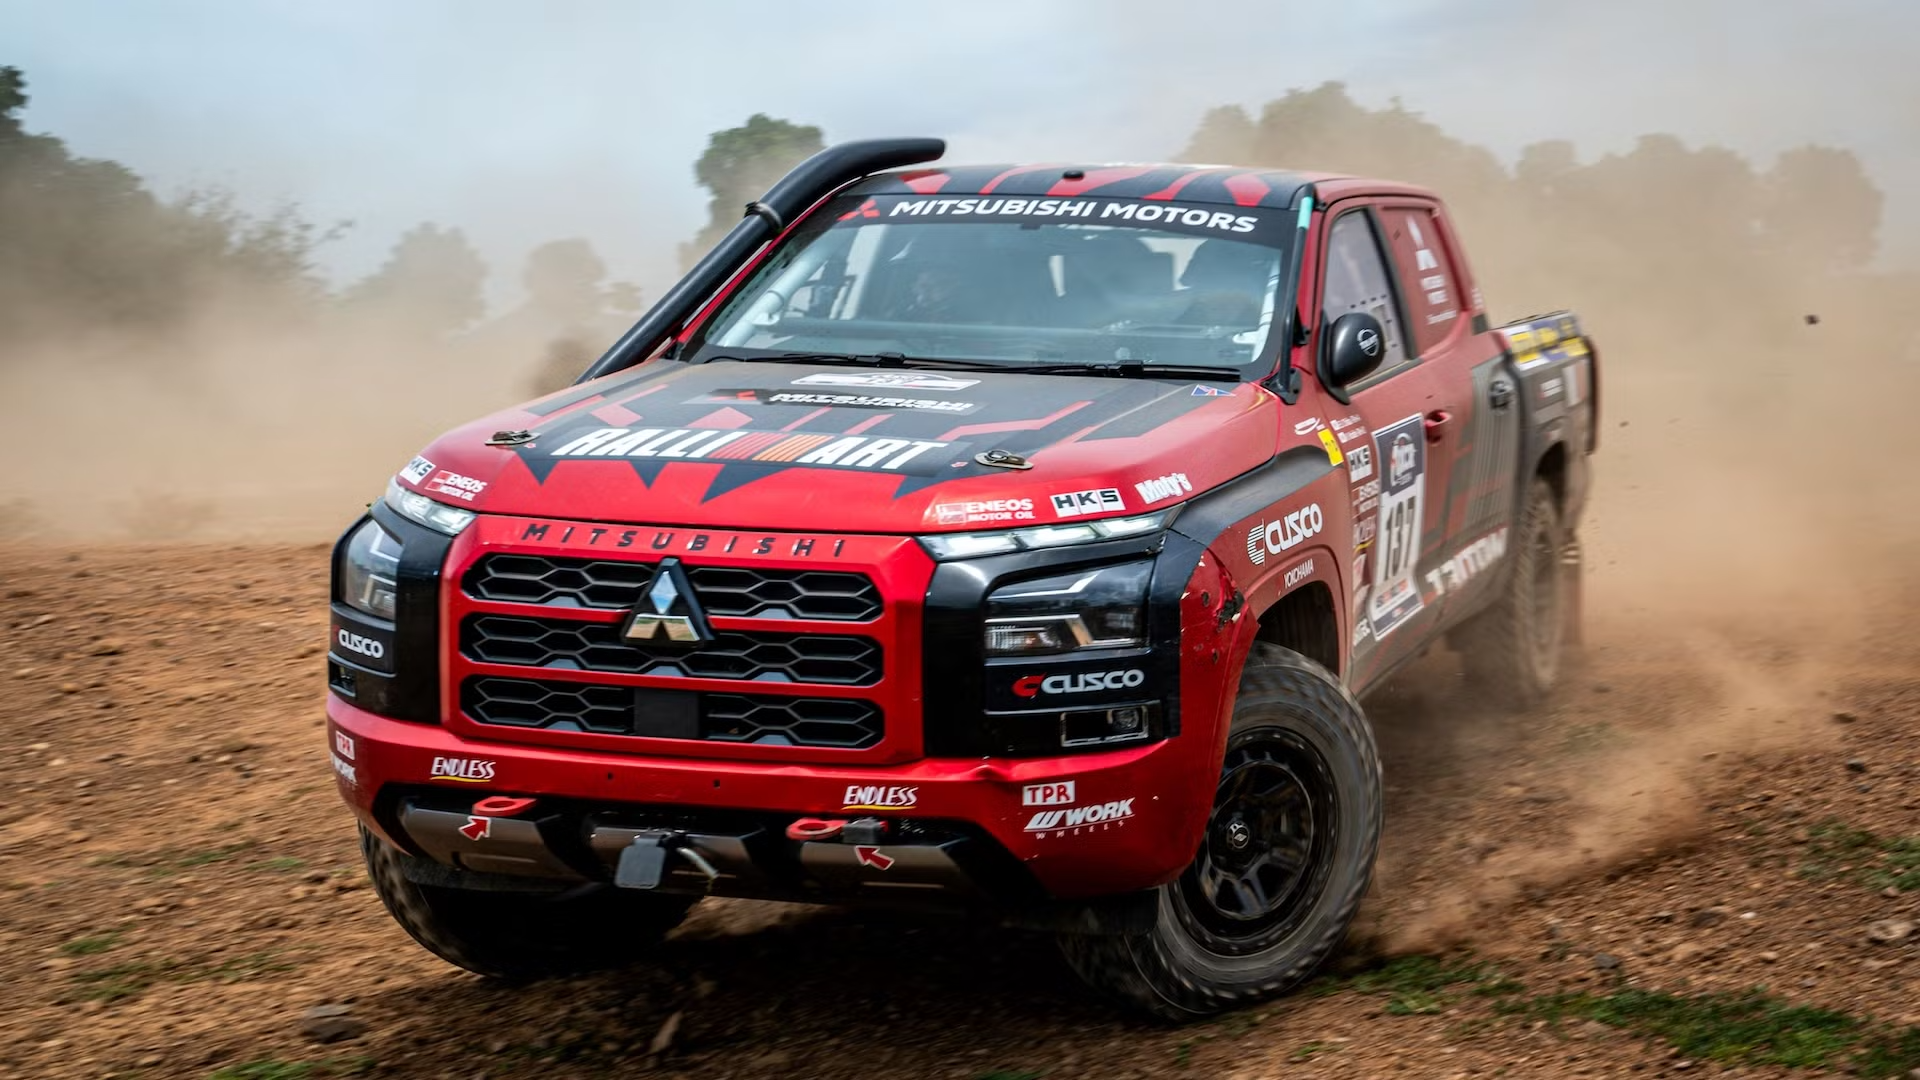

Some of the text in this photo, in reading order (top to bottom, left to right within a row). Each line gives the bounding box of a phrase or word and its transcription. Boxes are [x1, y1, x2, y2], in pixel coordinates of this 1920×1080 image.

[889, 199, 1258, 233] MITSUBISHI MOTORS
[408, 457, 433, 477] HKS
[1349, 447, 1370, 471] HKS
[445, 474, 487, 492] ENEOS
[1135, 473, 1192, 504] Moty's
[966, 499, 1034, 513] ENEOS
[1053, 490, 1119, 510] HKS
[966, 510, 1036, 522] MOTOR OIL
[522, 523, 846, 558] MITSUBISHI
[1265, 503, 1323, 555] CUSCO
[1385, 494, 1416, 582] 137
[1283, 558, 1314, 589] YOKOHAMA
[338, 628, 384, 659] CUSCO
[1041, 668, 1145, 694] CUSCO
[431, 756, 497, 780] ENDLESS
[843, 785, 919, 806] ENDLESS
[1026, 784, 1070, 803] TPR
[1065, 797, 1135, 827] WORK
[1036, 819, 1125, 840] WHEELS
